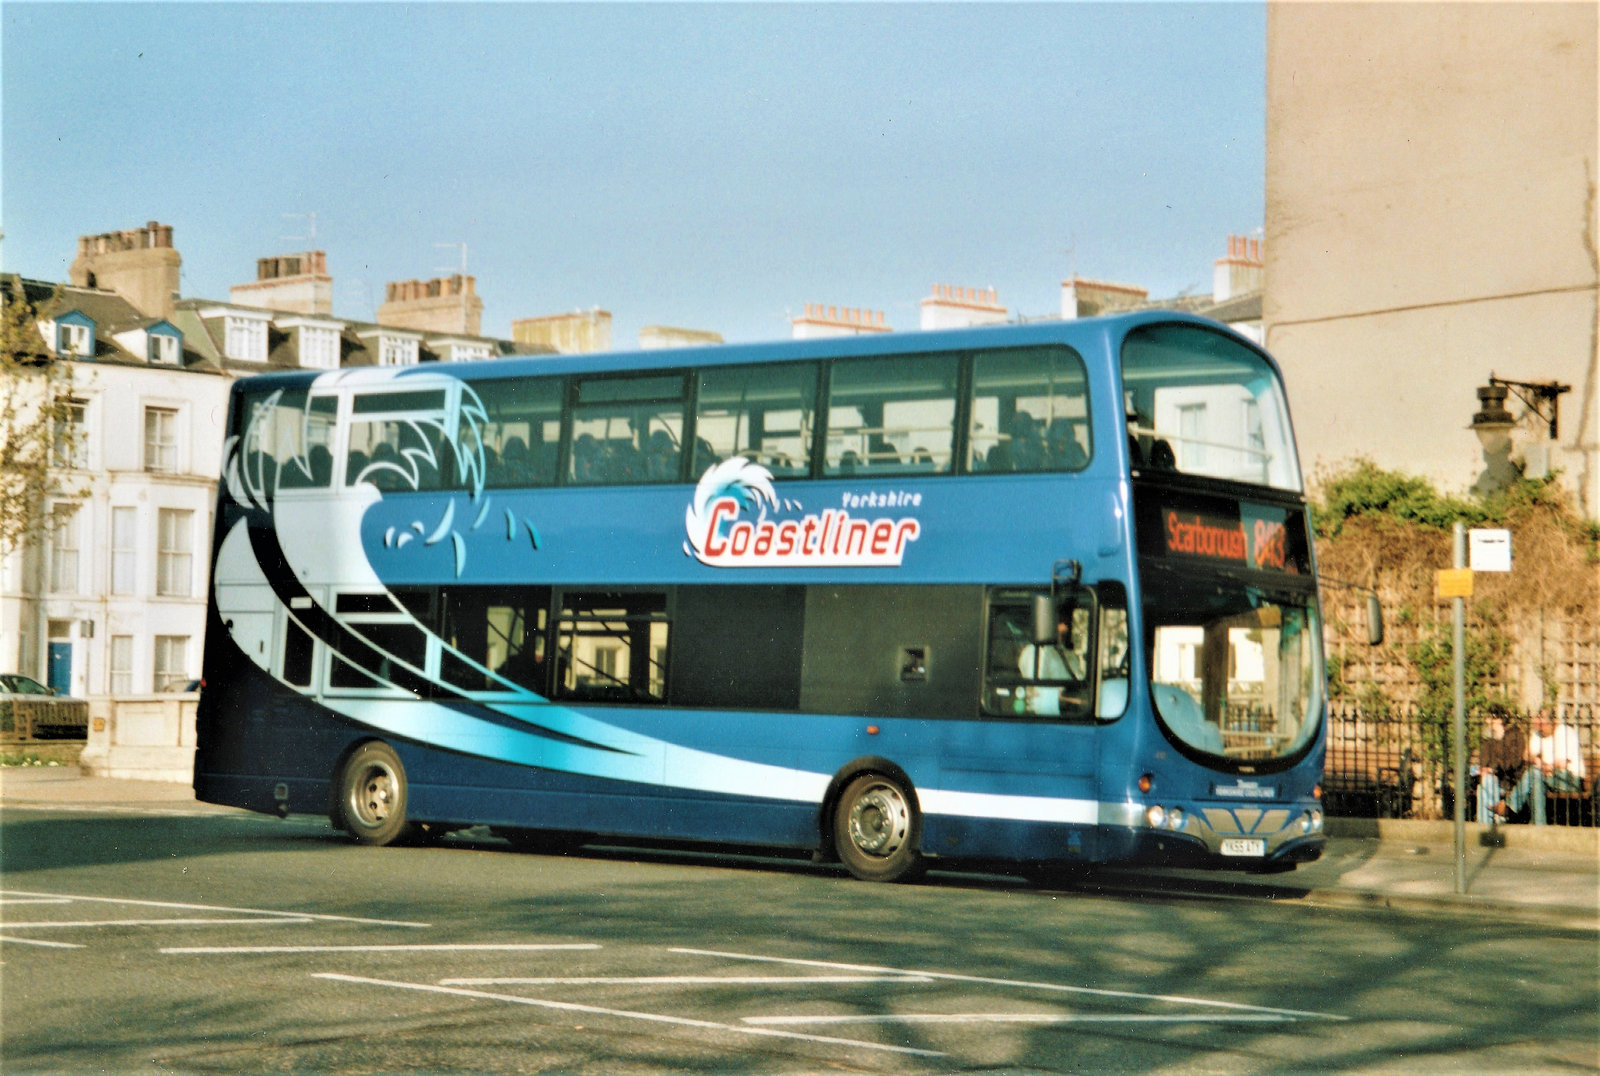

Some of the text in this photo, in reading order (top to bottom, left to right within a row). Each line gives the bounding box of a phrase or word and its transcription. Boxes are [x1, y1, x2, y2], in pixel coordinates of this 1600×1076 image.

[842, 490, 922, 508] Yorkshire
[704, 500, 917, 557] Coastliner
[1167, 511, 1248, 560] Scarborough
